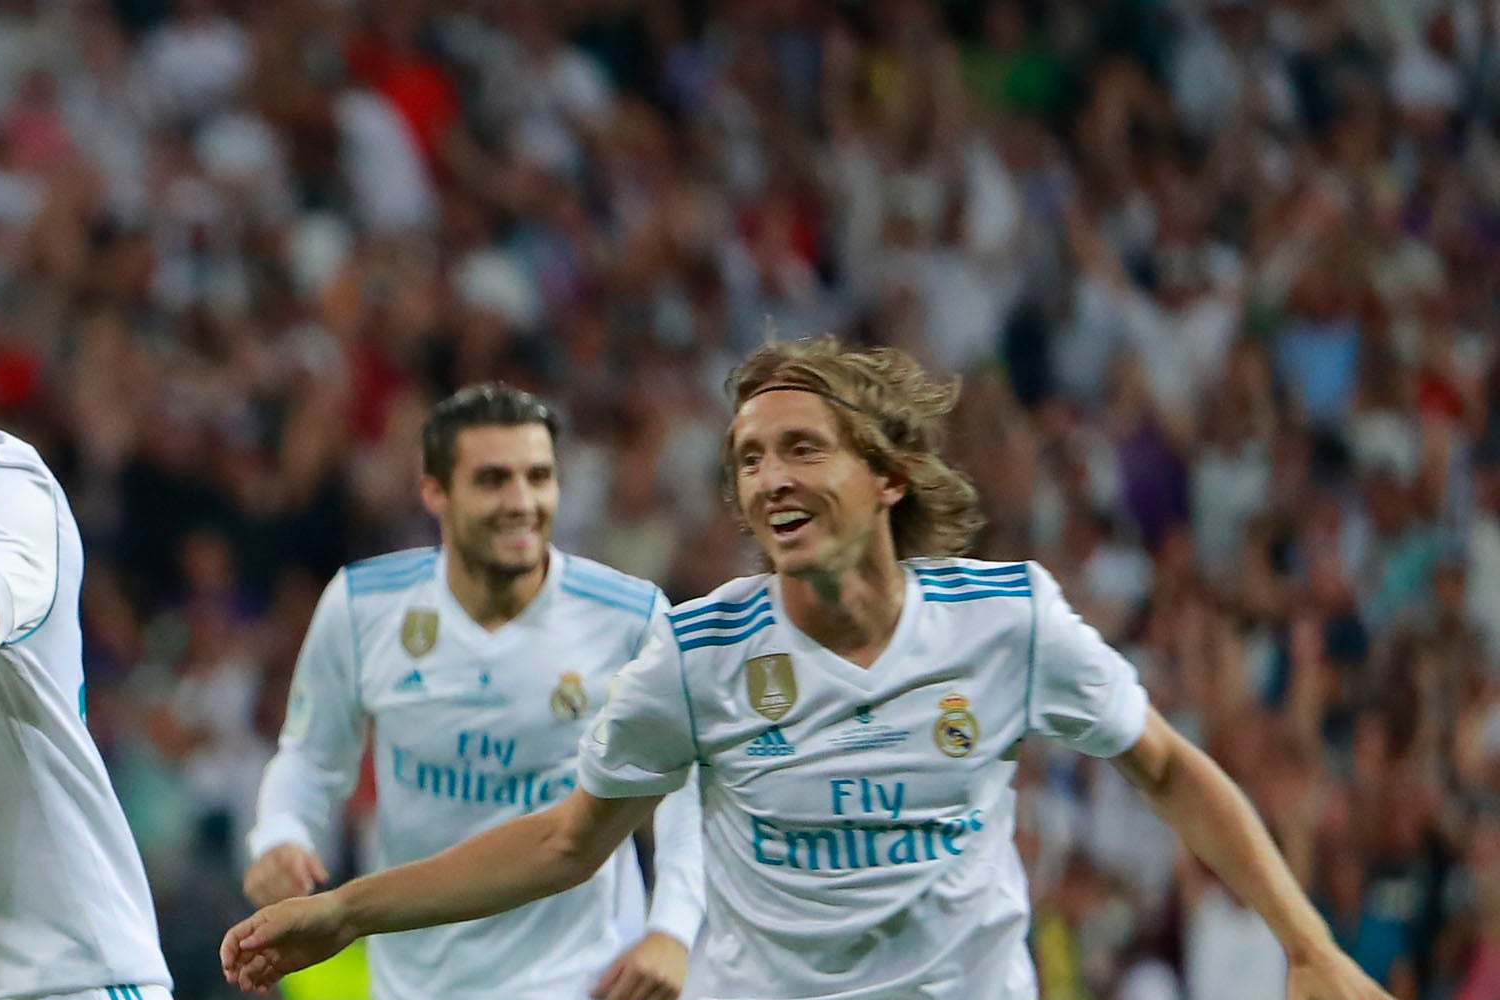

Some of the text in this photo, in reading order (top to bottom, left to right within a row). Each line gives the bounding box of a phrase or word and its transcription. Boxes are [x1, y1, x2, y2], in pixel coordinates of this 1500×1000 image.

[457, 728, 516, 768] Fly
[391, 744, 576, 813] Emirate
[830, 777, 905, 819] Fly
